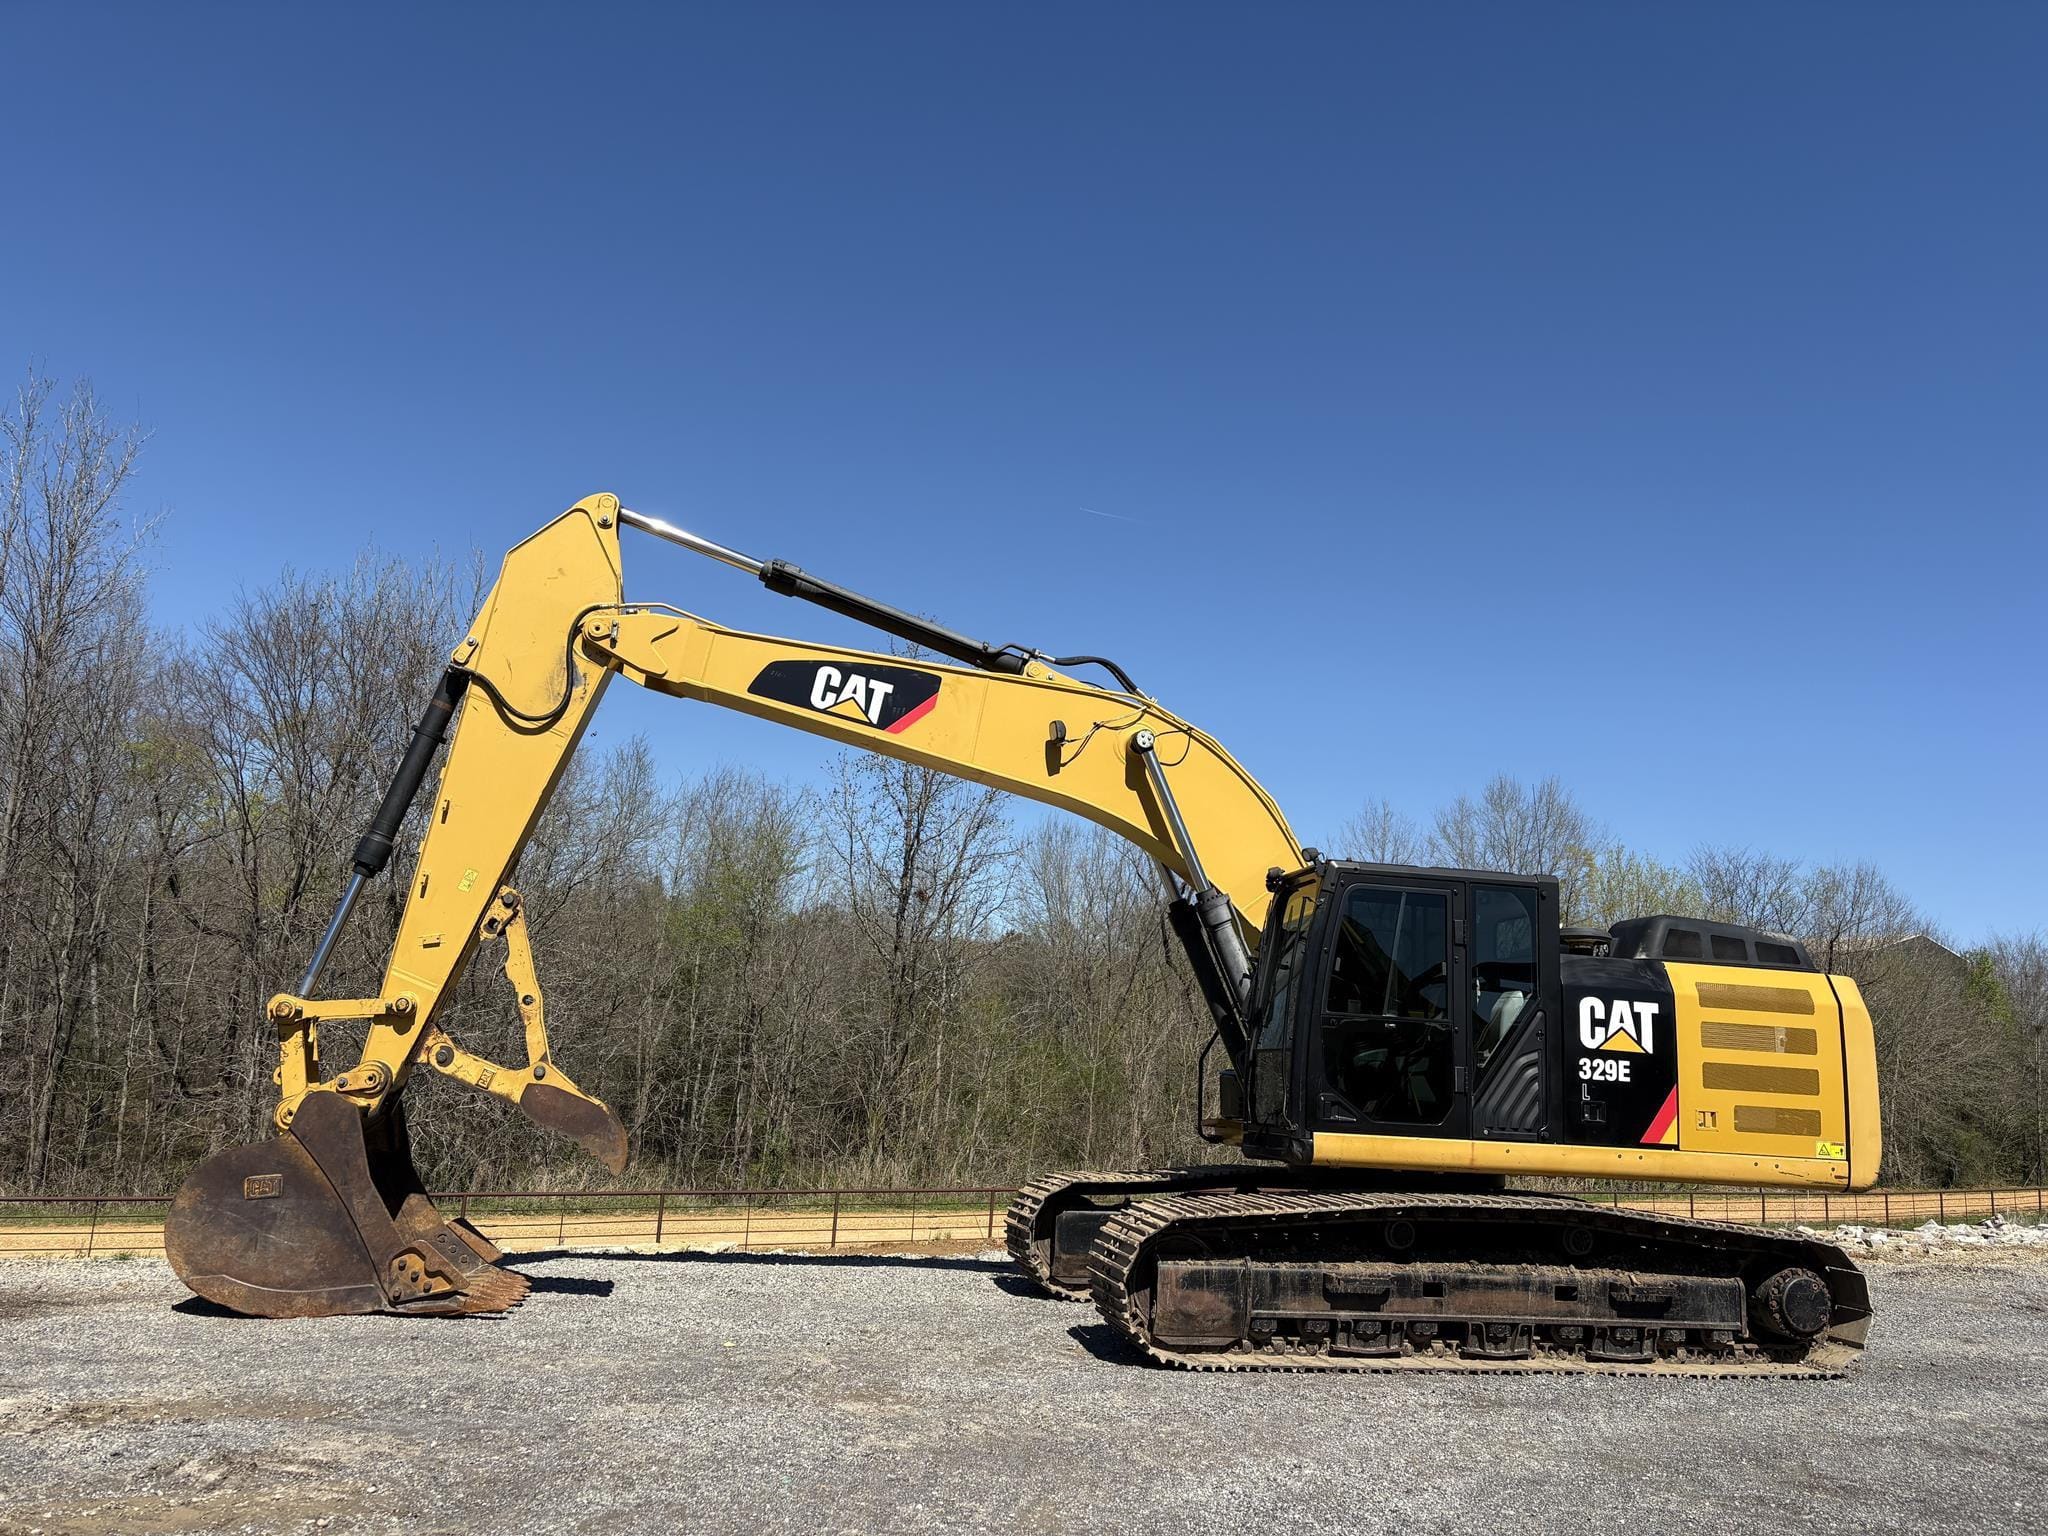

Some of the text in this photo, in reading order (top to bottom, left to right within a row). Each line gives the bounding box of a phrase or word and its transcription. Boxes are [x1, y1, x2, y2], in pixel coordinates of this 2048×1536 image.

[811, 666, 894, 724] CAT
[1579, 996, 1659, 1054] CAT
[1579, 1058, 1630, 1082] 329E
[1582, 1083, 1590, 1100] L
[249, 1179, 280, 1197] CAT
